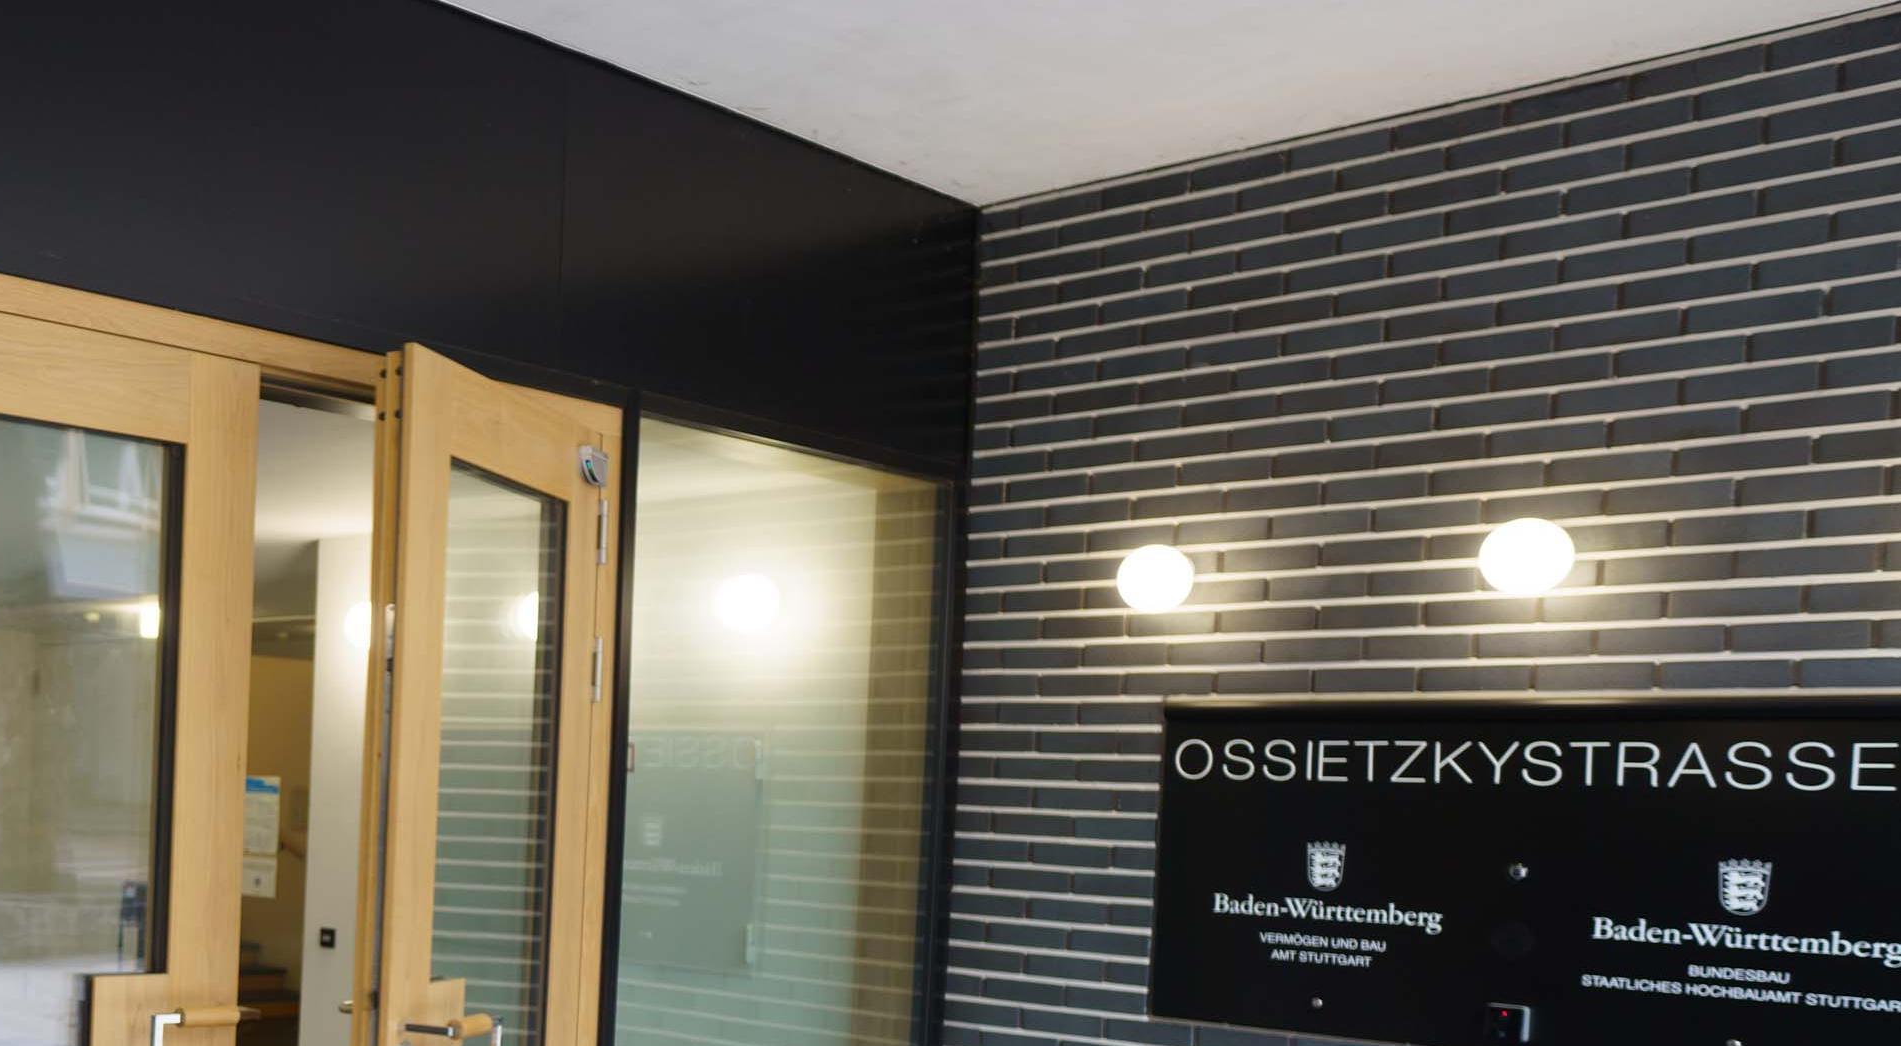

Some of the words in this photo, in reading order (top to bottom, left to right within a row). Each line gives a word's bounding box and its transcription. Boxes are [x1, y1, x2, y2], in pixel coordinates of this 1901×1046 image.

[1173, 737, 1900, 793] OSSIETZKYSTRASSE
[1212, 891, 1444, 936] Baden-Württemberg
[1259, 931, 1329, 949] VERMÖGEN
[1331, 937, 1359, 951] UND
[1360, 939, 1387, 953] BAU
[1591, 915, 1901, 969] Baden-Württemberg
[1270, 949, 1296, 962] AMT
[1298, 950, 1373, 968] STUTTGART
[1580, 974, 1683, 995] STAATLICHES
[1685, 982, 1803, 1005] HOCHBAUAMT
[1687, 963, 1791, 986] BUNDESBAU
